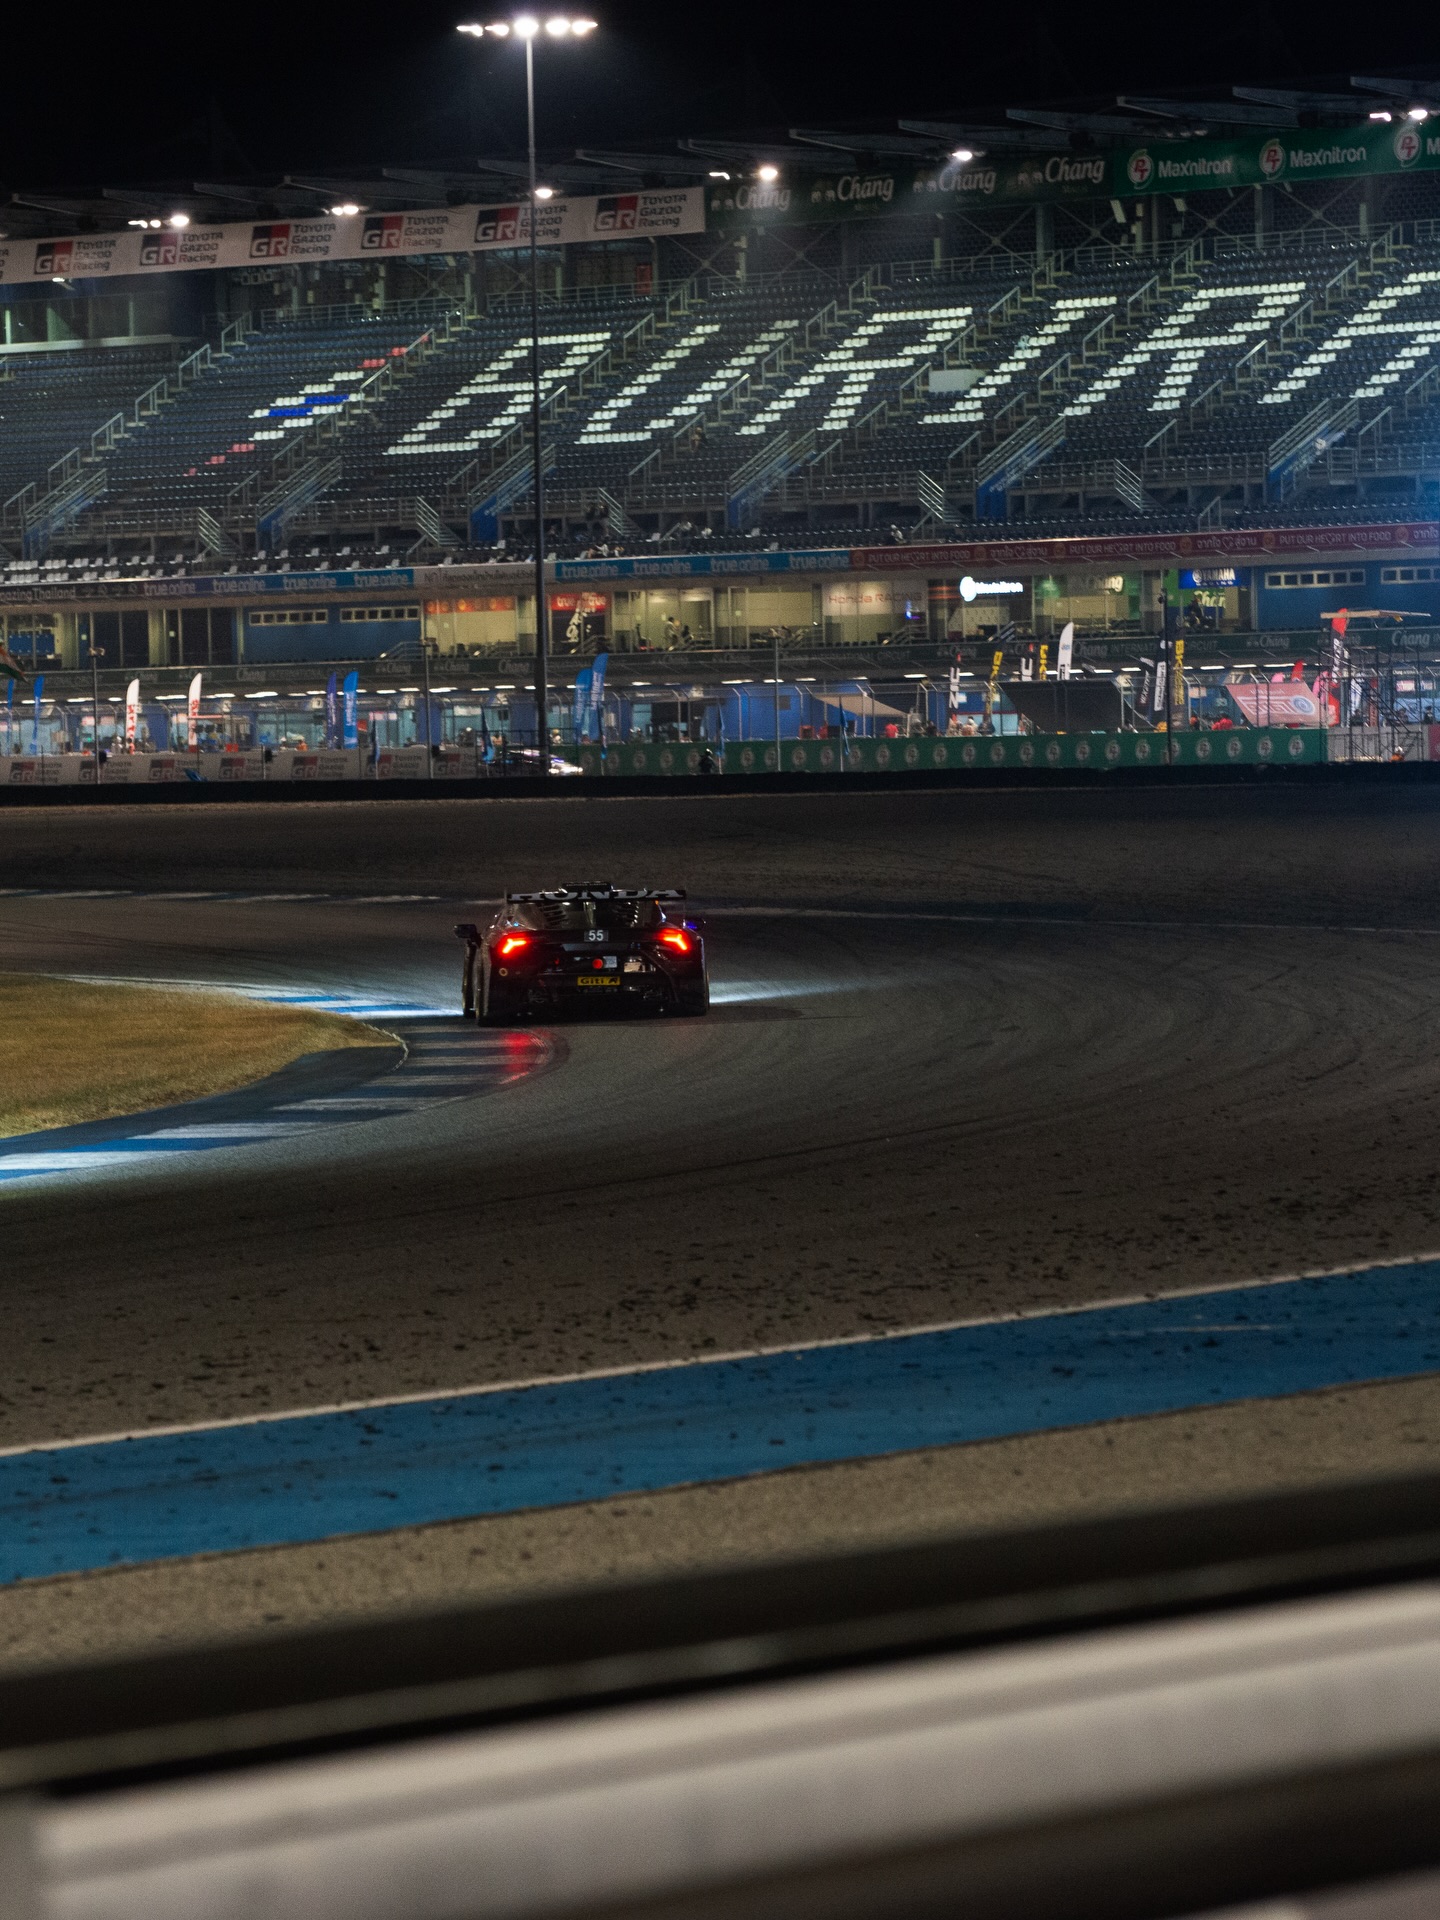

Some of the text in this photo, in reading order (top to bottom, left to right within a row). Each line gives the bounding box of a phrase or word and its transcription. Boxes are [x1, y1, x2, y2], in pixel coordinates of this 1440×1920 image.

[1290, 146, 1366, 167] Maxnitron
[1045, 157, 1105, 183] Chang
[1158, 156, 1233, 178] Maxnitron
[938, 170, 996, 194] Chang
[837, 176, 895, 201] Chang
[642, 194, 687, 206] TOYOTA
[735, 186, 791, 211] Chang
[522, 205, 568, 216] TYOTA
[640, 206, 682, 217] GAZOO
[405, 215, 449, 226] TOYOTA
[520, 217, 562, 228] GZOO
[594, 209, 636, 232] GR
[639, 217, 680, 228] Racing
[293, 223, 336, 233] TOYOTA
[404, 227, 444, 237] GAZOO
[475, 221, 517, 243] GR
[519, 228, 560, 239] Rcing
[182, 232, 223, 242] TOYOTA
[292, 234, 332, 244] GAZOO
[361, 227, 402, 249] GR
[75, 240, 117, 250] TOYOTA
[180, 243, 219, 253] GAZOO
[250, 237, 288, 258] GR
[402, 238, 443, 249] Racing
[140, 245, 177, 266] GR
[290, 245, 330, 256] Racing
[34, 253, 72, 274] GR
[179, 254, 217, 264] Racing
[1279, 536, 1295, 545] PUT
[1070, 545, 1085, 555] PUT
[868, 554, 883, 564] PUT
[33, 586, 76, 601] Thailand
[1259, 634, 1290, 648] Chang
[1391, 629, 1431, 647] Chang
[588, 929, 604, 941] 55
[580, 977, 604, 986] Giti
